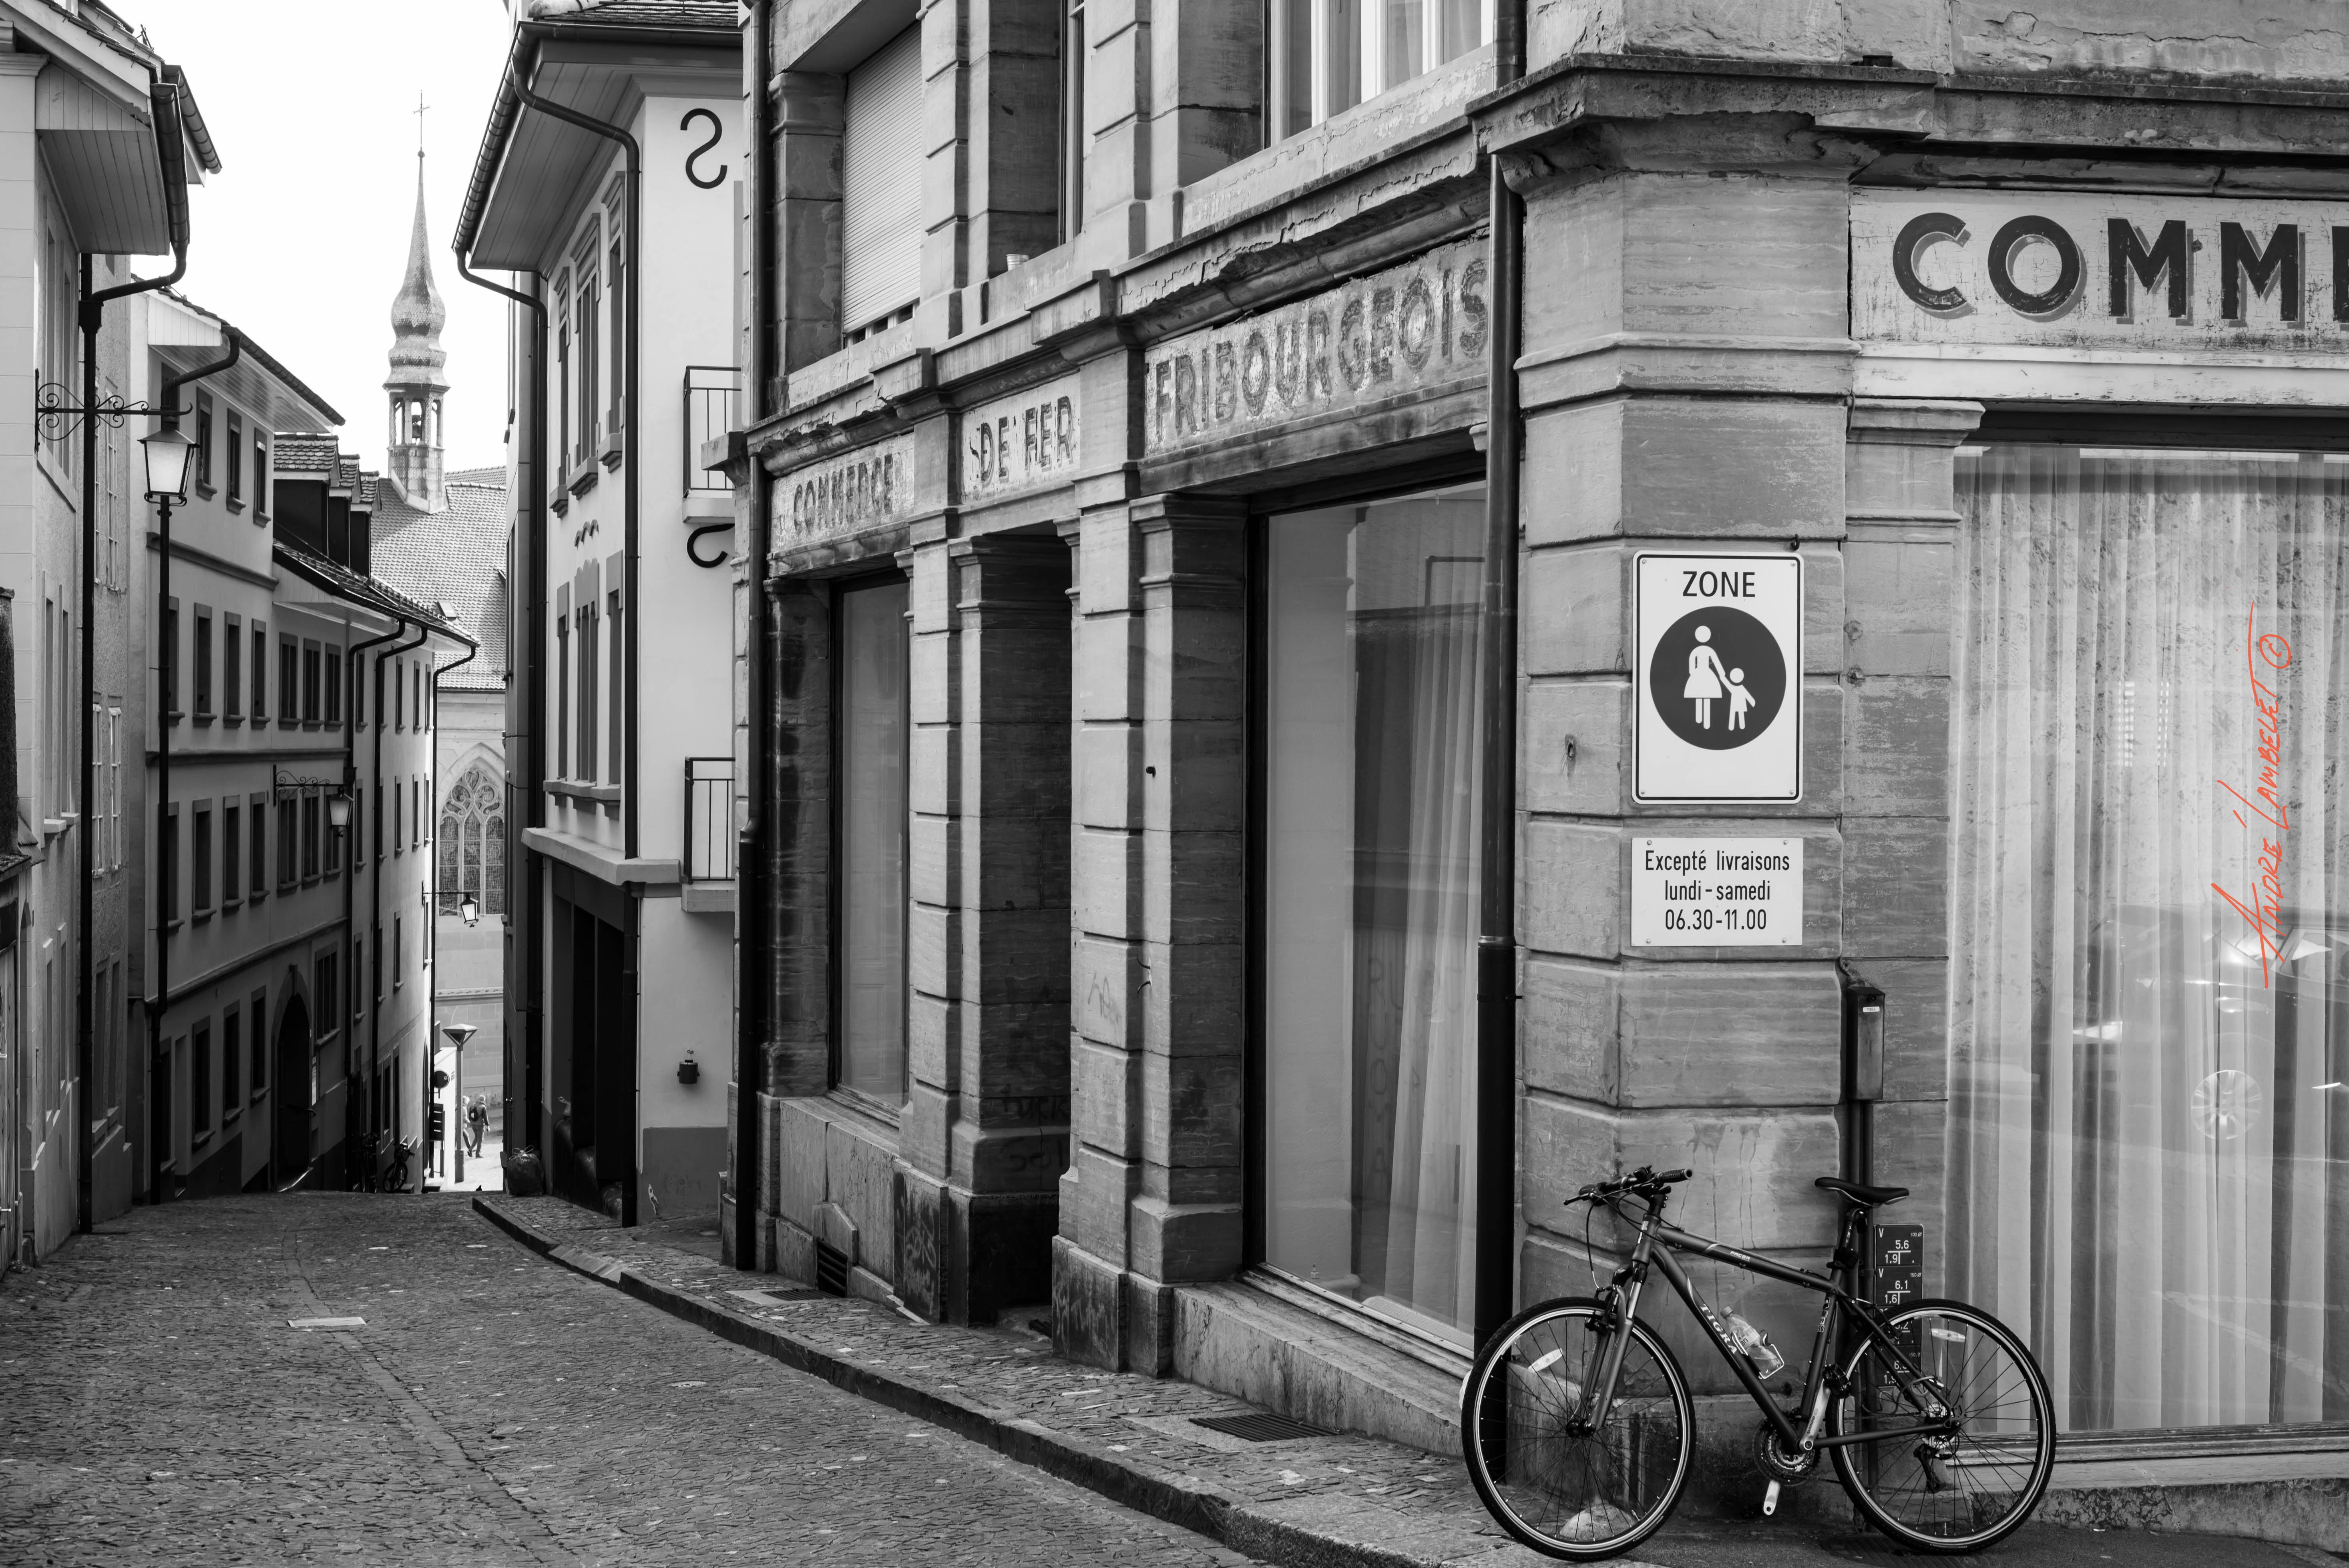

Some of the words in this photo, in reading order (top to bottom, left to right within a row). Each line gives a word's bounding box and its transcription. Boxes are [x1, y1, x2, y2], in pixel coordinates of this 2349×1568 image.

[981, 422, 1009, 488] DE
[1025, 396, 1074, 476] FER
[1156, 257, 1489, 436] FRIBOURGEOIS
[1683, 571, 1756, 598] ZONE
[1646, 850, 1707, 877] Excepté
[1716, 850, 1790, 871] livraisons
[1666, 909, 1767, 931] 06.30-11.00
[1879, 1228, 1884, 1238] V
[1895, 1240, 1909, 1250] 5,6
[1885, 1254, 1898, 1264] 1,9
[1879, 1268, 1884, 1278] V
[1895, 1280, 1908, 1290] 6,1
[1884, 1294, 1897, 1304] 1,6
[1700, 1304, 1737, 1354] TIGRA
